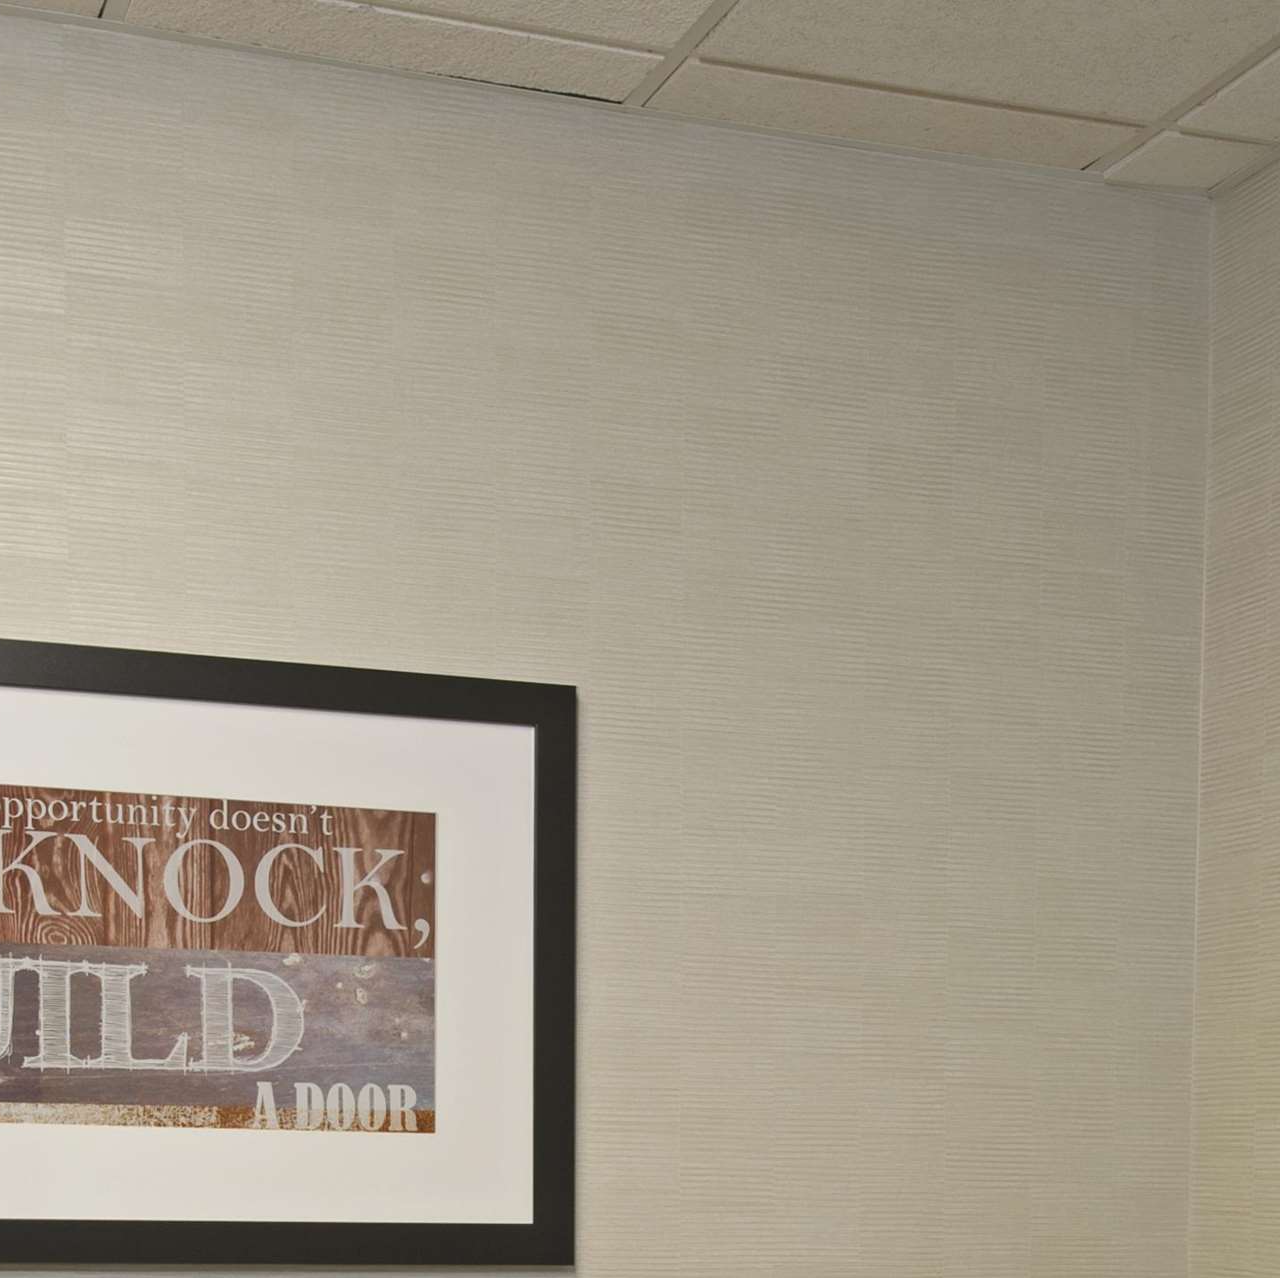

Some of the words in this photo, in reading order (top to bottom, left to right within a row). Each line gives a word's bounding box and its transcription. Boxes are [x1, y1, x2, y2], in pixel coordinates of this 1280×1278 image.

[209, 799, 334, 837] doesn't
[253, 1081, 280, 1129] A
[294, 1082, 418, 1132] DOOR
